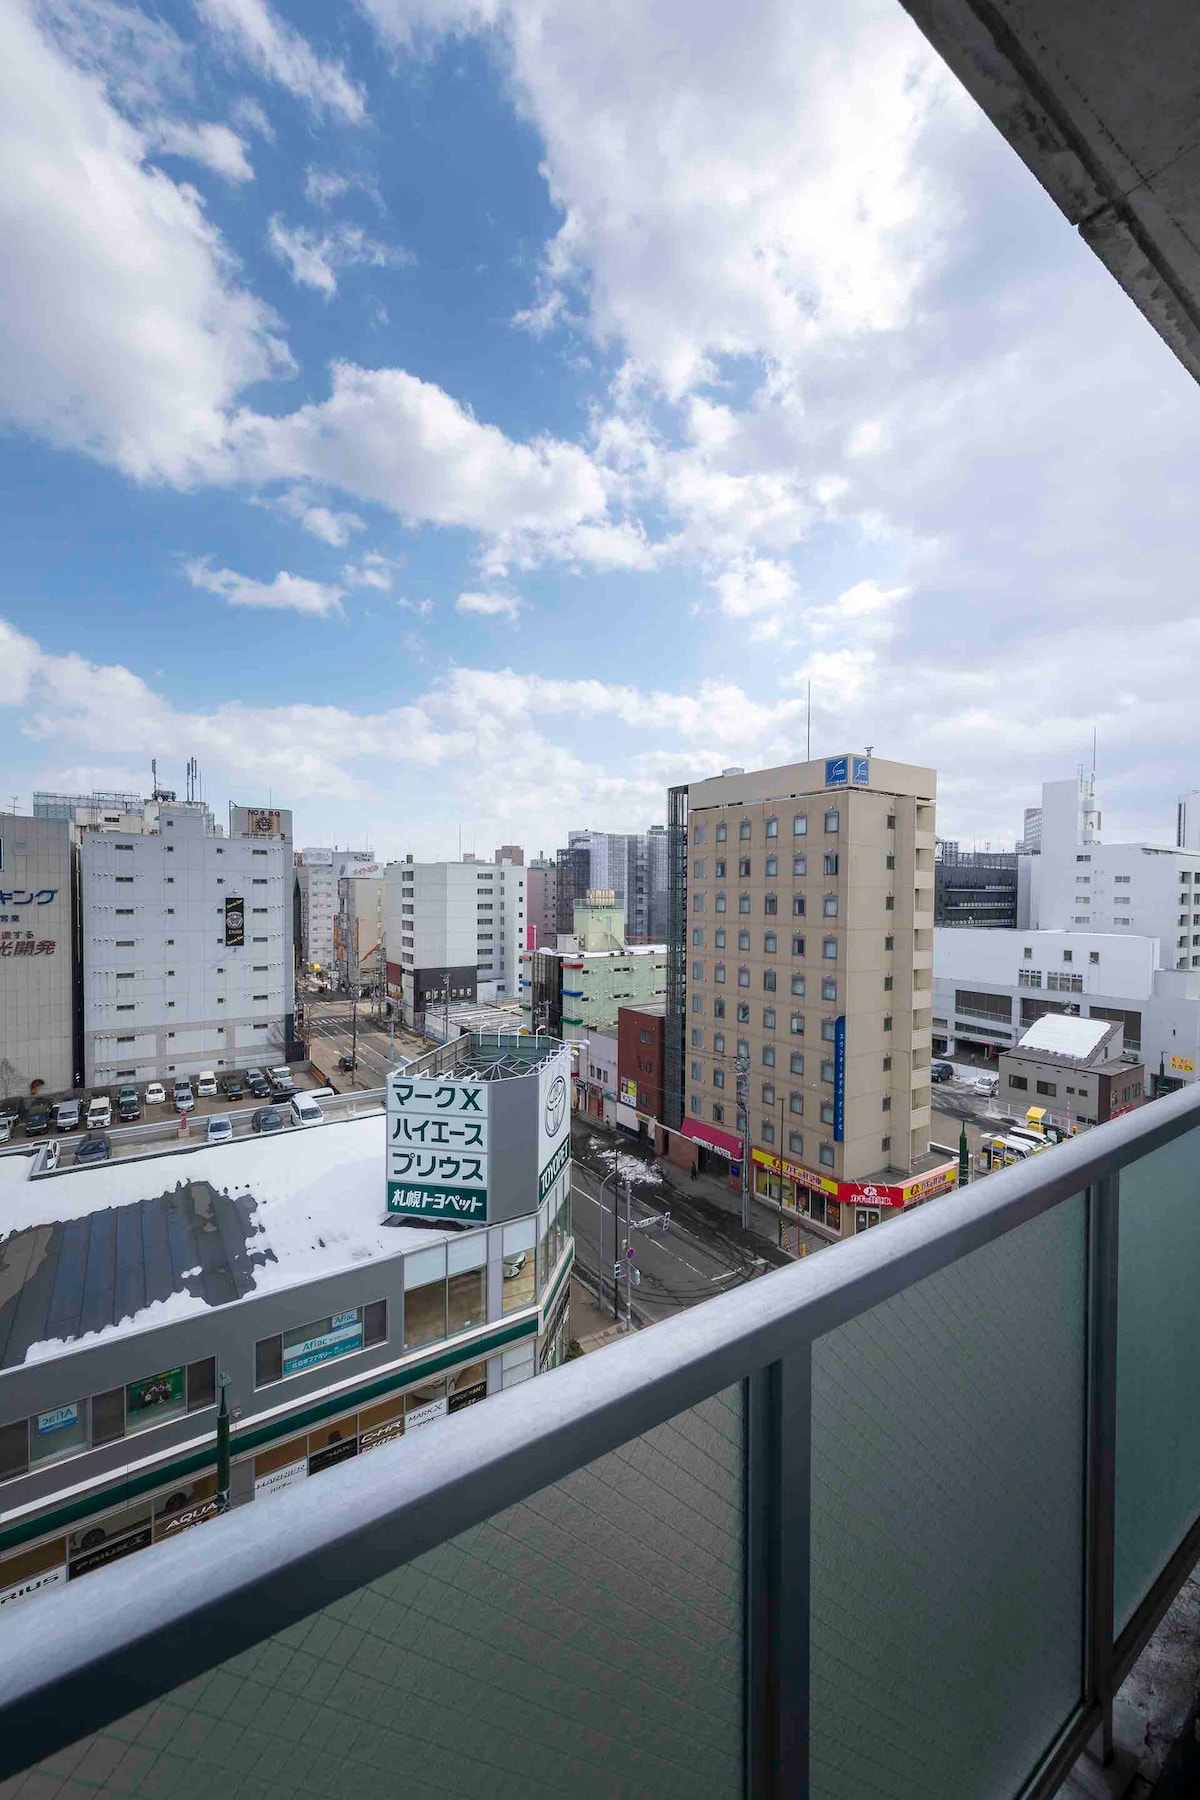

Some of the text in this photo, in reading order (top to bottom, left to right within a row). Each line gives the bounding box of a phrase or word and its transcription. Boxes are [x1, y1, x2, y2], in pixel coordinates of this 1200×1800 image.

[392, 1118, 483, 1147] ハイエース
[392, 1152, 483, 1182] プリウス
[392, 1189, 484, 1213] 札幌トヨペット
[165, 1502, 218, 1531] AQUA
